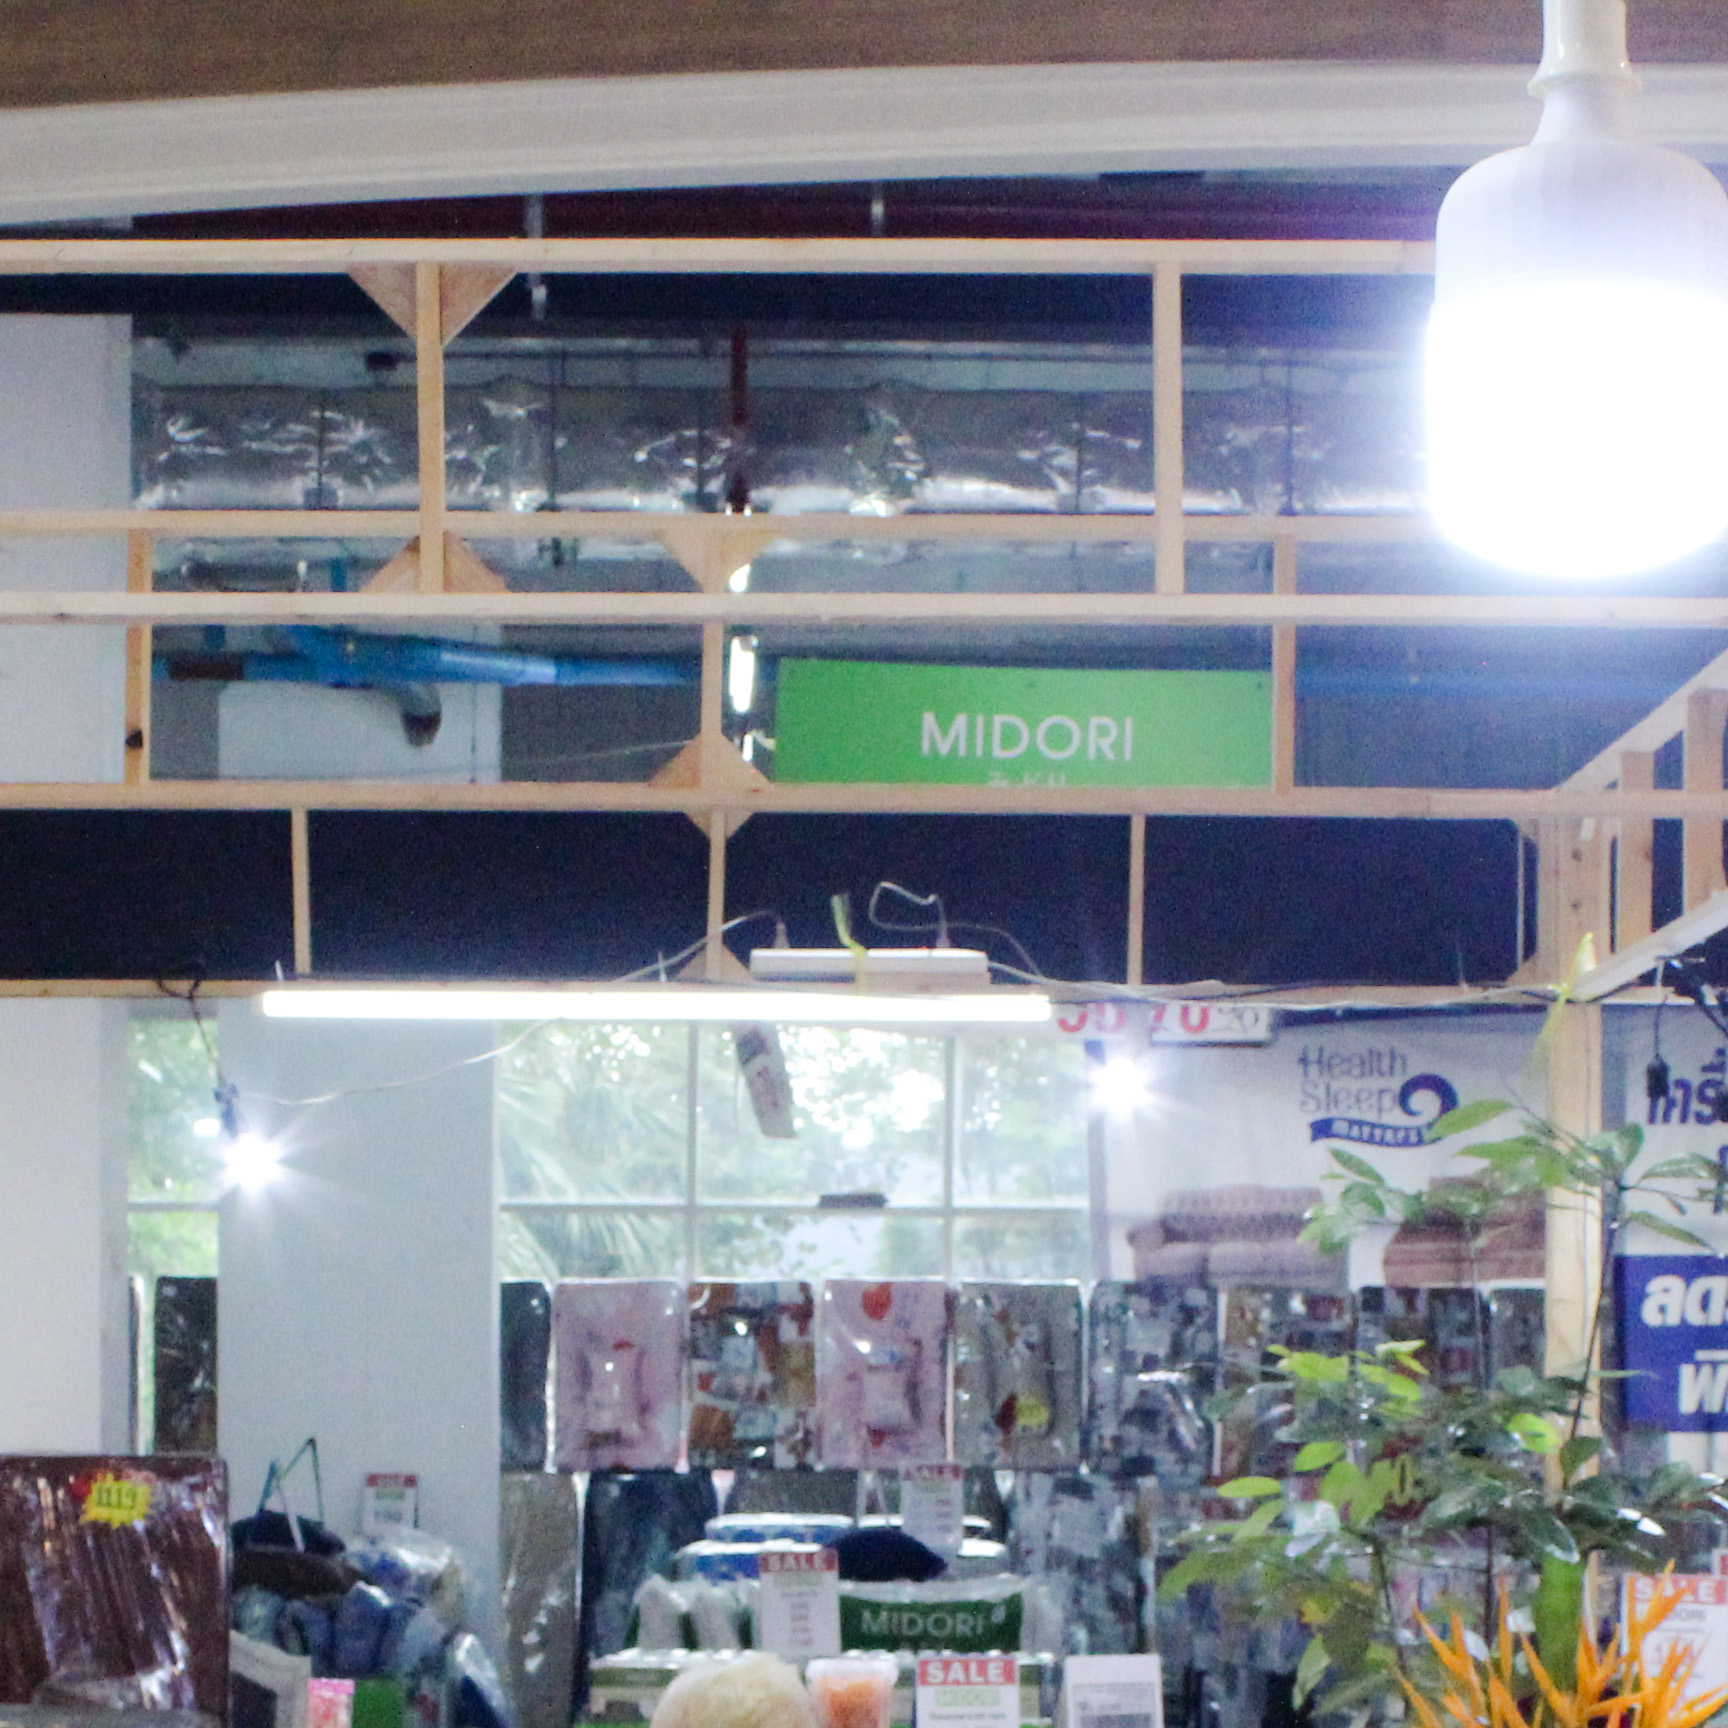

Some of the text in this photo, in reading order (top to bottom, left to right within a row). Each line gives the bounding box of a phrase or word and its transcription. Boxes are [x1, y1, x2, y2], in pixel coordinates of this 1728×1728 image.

[921, 711, 1133, 761] MIDORI
[1298, 1045, 1408, 1080] Health
[1299, 1083, 1398, 1124] Sleep
[862, 1610, 985, 1637] MIDORI
[927, 1661, 1006, 1684] SALE
